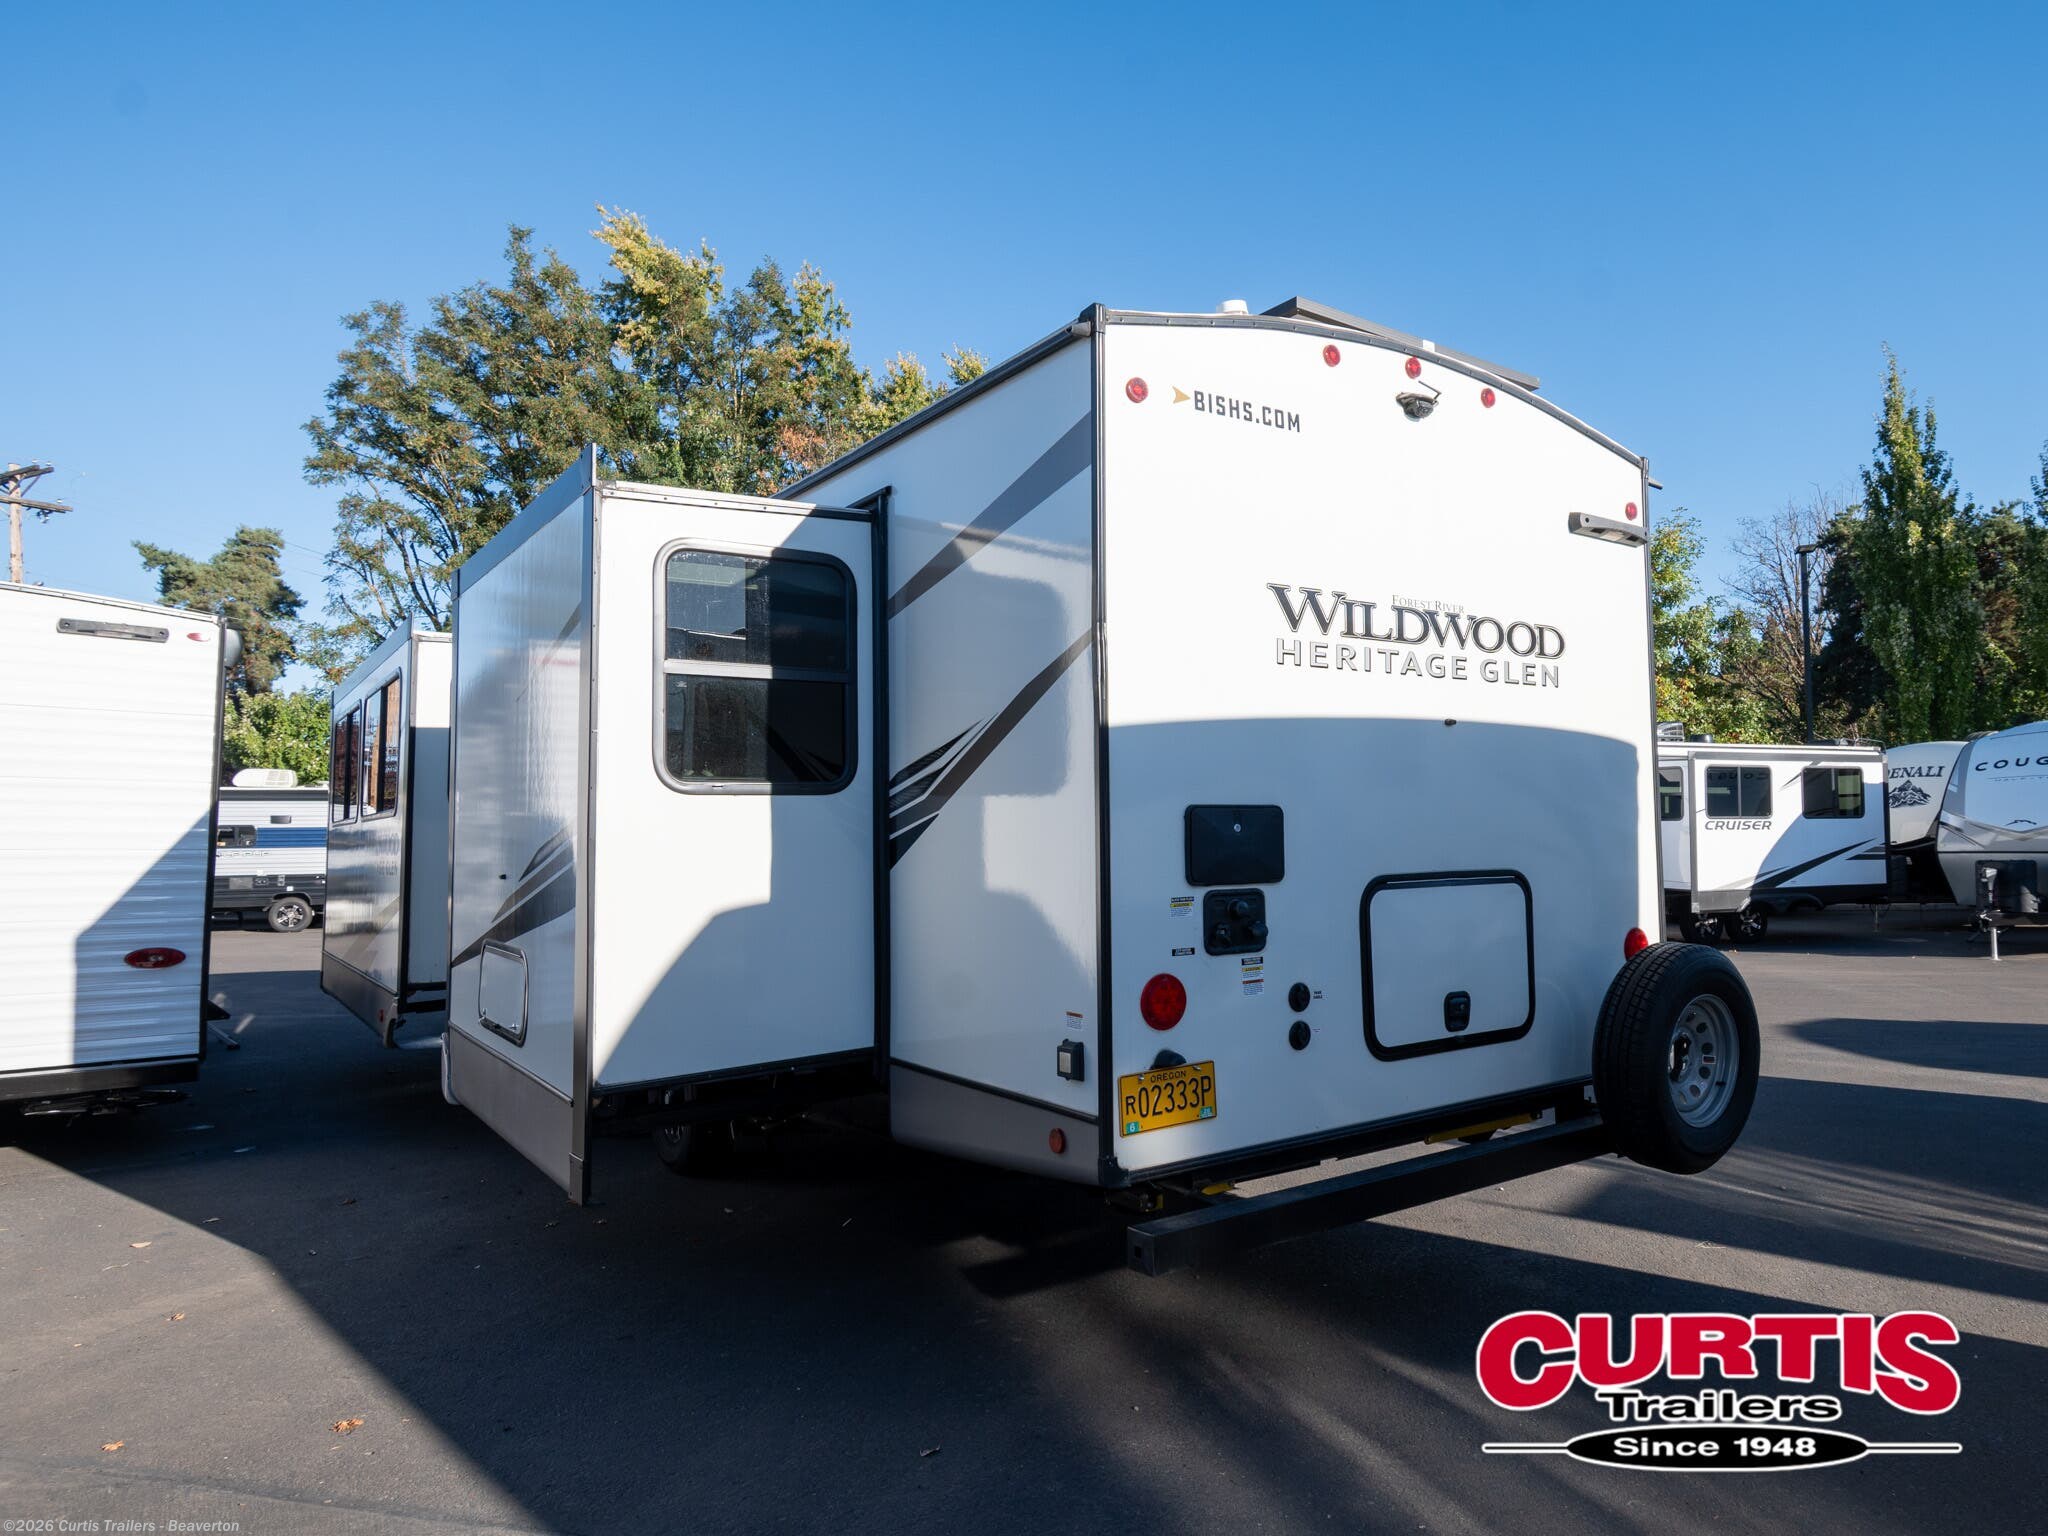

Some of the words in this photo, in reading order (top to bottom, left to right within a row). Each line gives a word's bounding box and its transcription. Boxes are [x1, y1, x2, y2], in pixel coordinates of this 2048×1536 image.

[1194, 390, 1301, 433] BISHS.COM
[1266, 582, 1566, 660] WILDWOOD
[1275, 637, 1468, 680] HERITAGE
[1479, 659, 1560, 688] GLEN
[1888, 765, 1946, 779] ENALI
[1704, 820, 1772, 830] CRUISER
[1126, 1075, 1212, 1118] R02333P
[1150, 1070, 1187, 1083] OREGON
